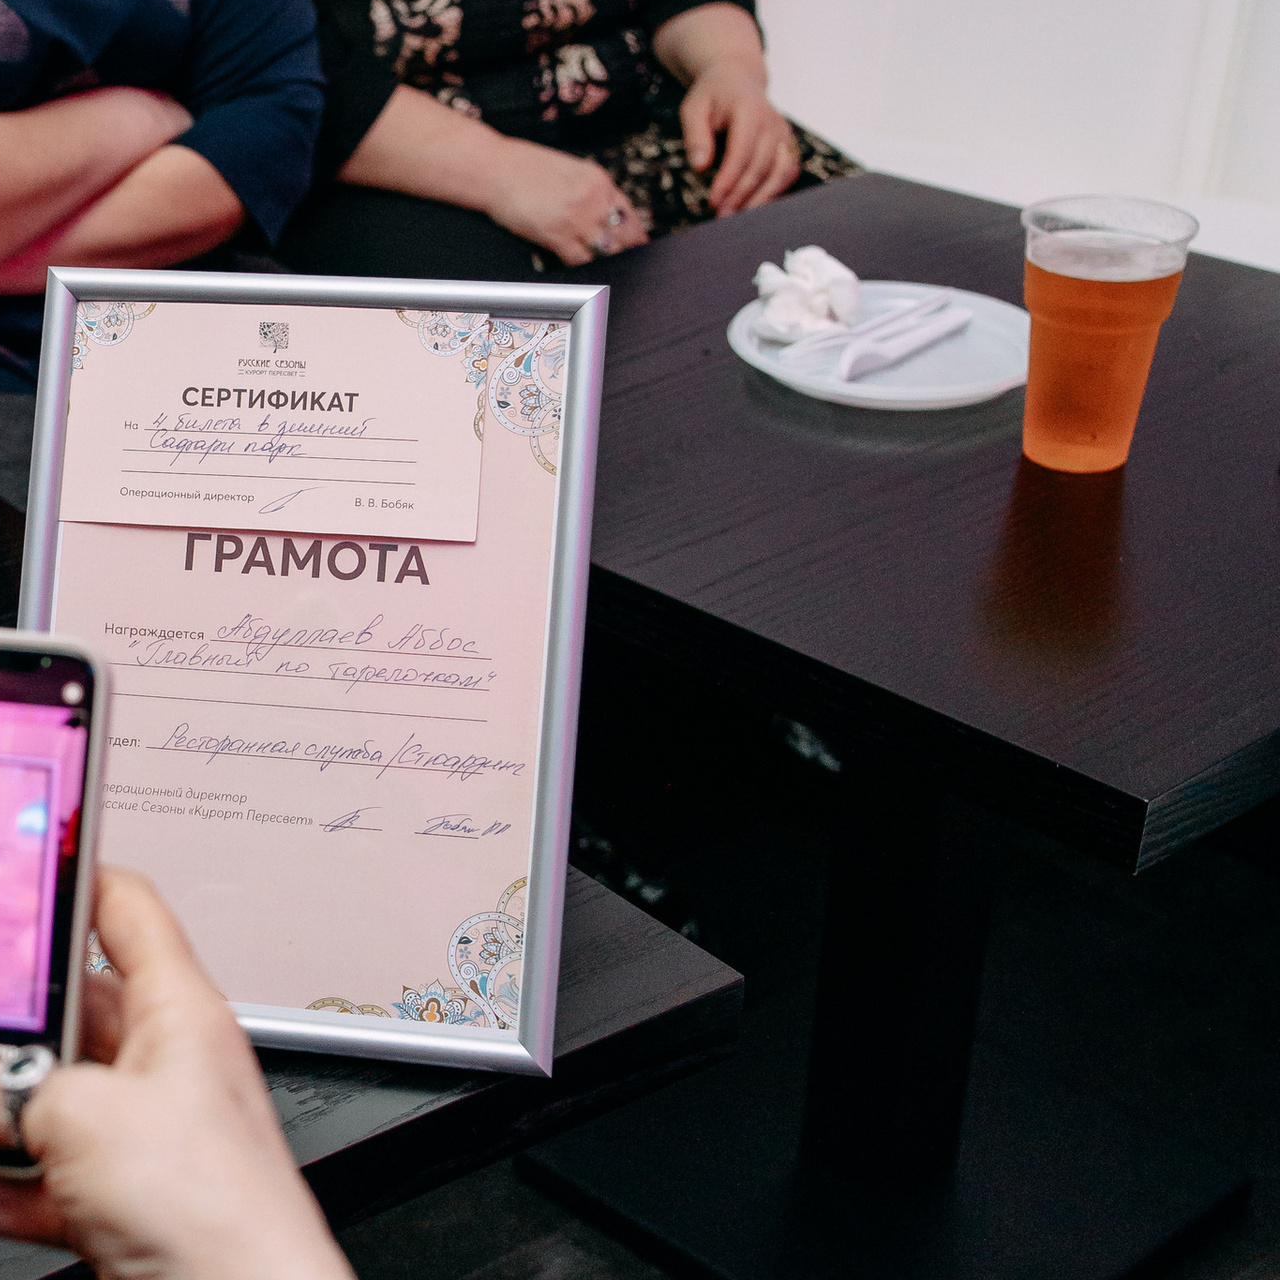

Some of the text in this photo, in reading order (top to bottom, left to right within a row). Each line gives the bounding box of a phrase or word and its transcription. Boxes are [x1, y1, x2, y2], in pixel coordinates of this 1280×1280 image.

[238, 358, 307, 369] РУССКИЕ СЕЗОНЫ
[181, 386, 360, 413] СЕРТИФИКАТ
[124, 420, 139, 431] На
[119, 486, 201, 502] Операционный
[204, 491, 255, 503] директор
[355, 498, 415, 510] В. В. Бобяк
[184, 532, 430, 586] ГРАМОТА
[104, 623, 205, 640] Награждается
[387, 624, 479, 654] Аббос
[108, 736, 141, 748] тдел:
[102, 783, 248, 804] перационный директор
[100, 800, 138, 812] усские
[141, 800, 186, 815] Сезоны
[188, 804, 244, 821] «Курорт
[246, 809, 313, 826] Пересвет»
